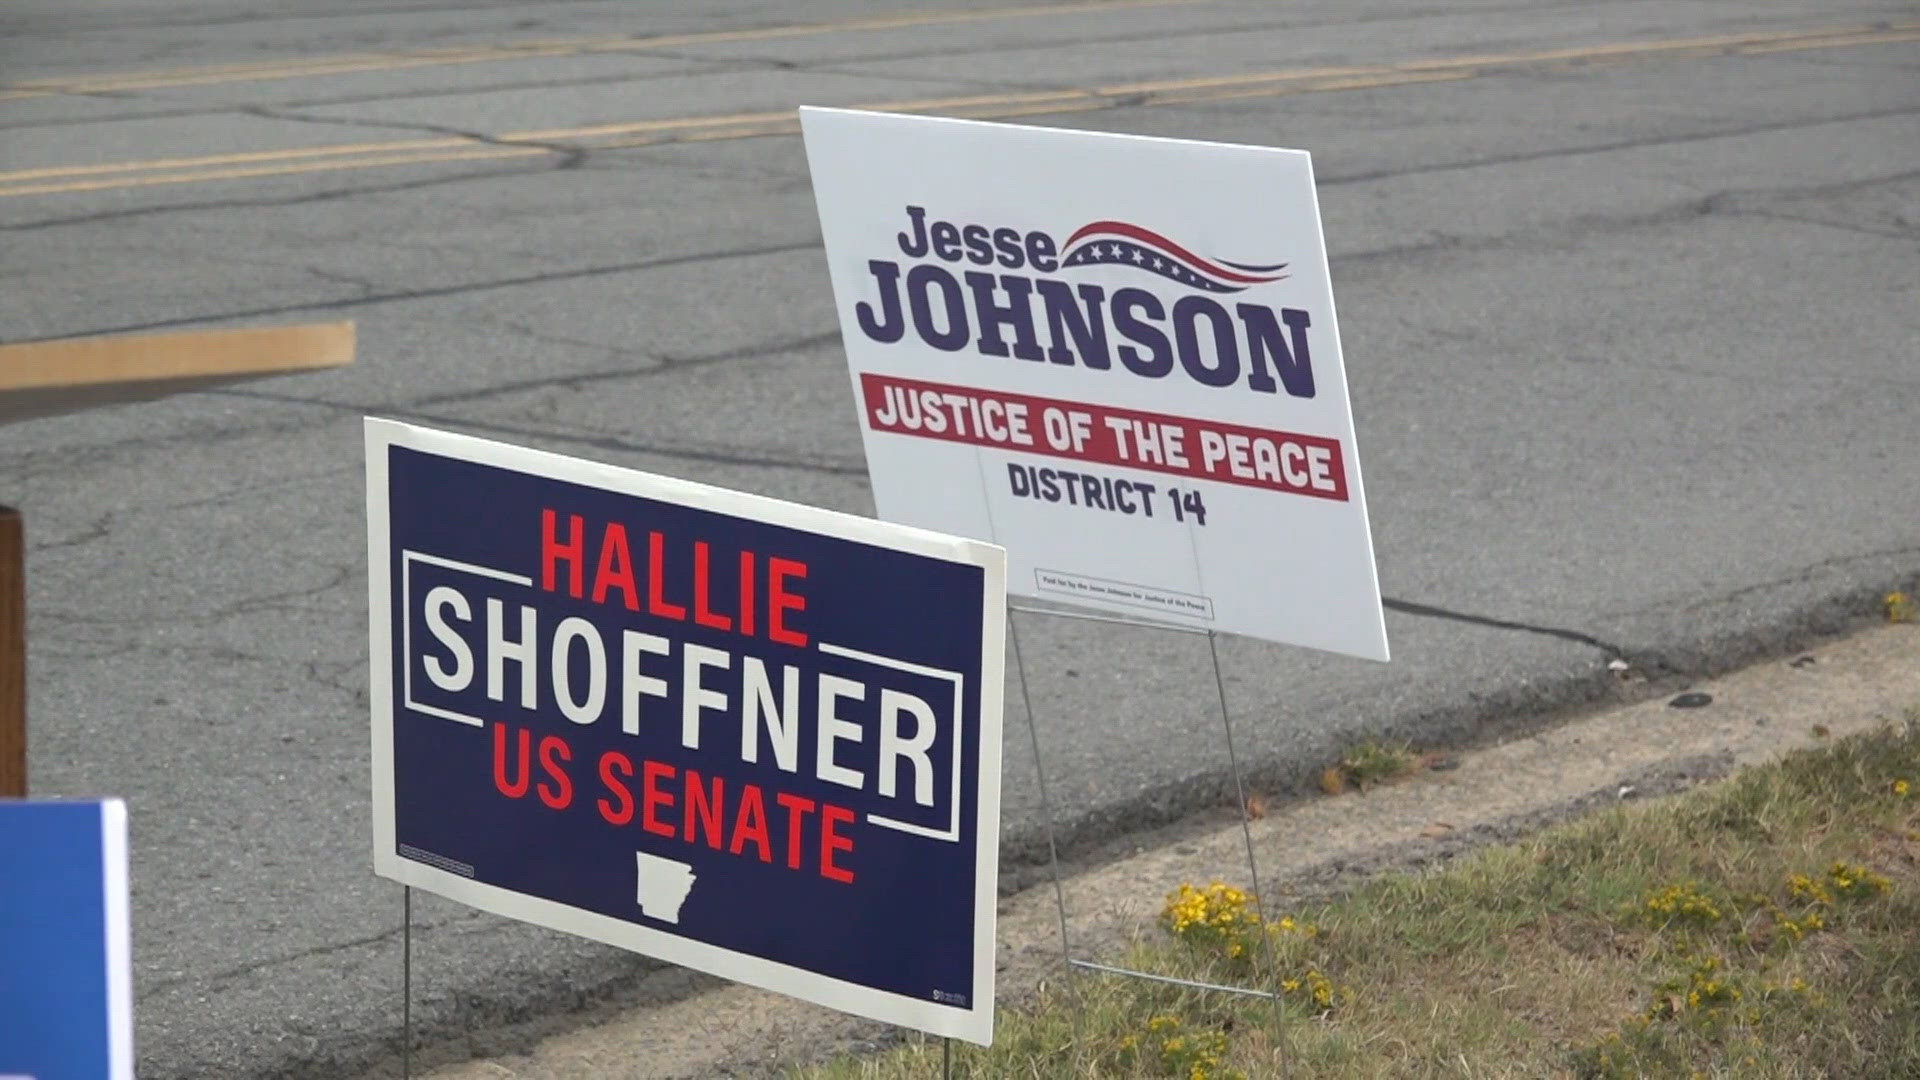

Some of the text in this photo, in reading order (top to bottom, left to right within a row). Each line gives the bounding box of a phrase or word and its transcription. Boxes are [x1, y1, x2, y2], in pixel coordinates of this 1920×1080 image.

[898, 206, 1059, 272] Jesse
[856, 260, 1315, 398] JOHNSON
[876, 386, 1335, 491] JUSTICE OF THE PEACE
[1008, 463, 1206, 526] DISTRICT 14
[543, 510, 807, 646] HALLIE
[423, 587, 936, 807] SHOFFNER
[495, 723, 855, 882] US SENATE
